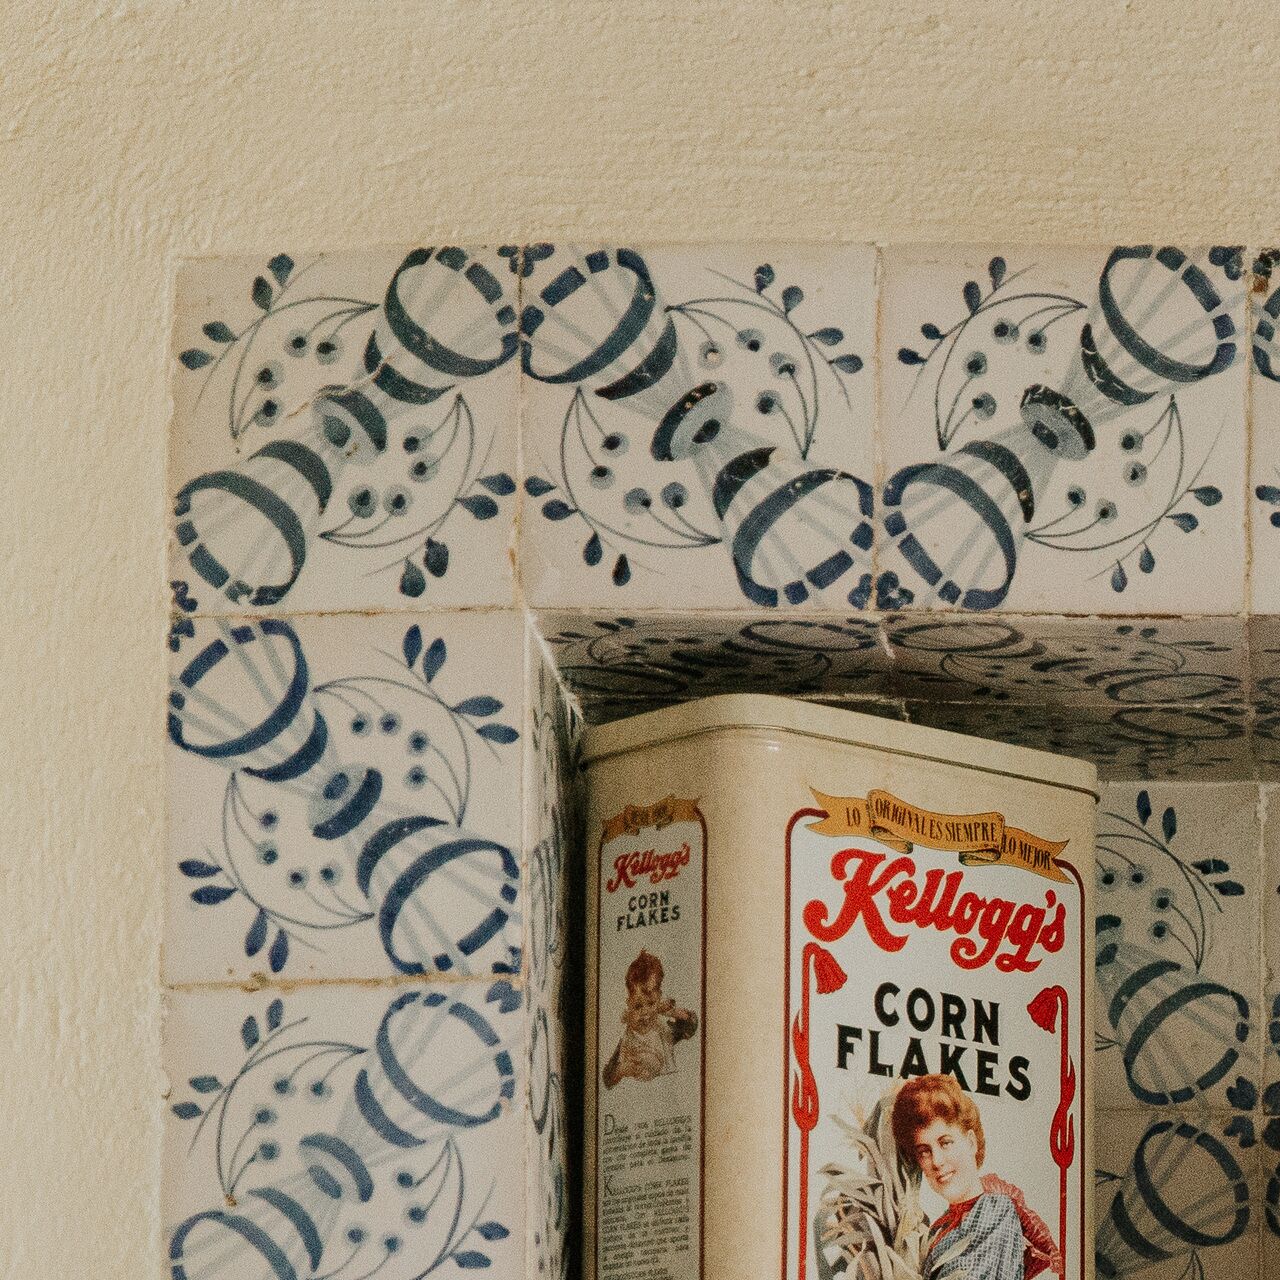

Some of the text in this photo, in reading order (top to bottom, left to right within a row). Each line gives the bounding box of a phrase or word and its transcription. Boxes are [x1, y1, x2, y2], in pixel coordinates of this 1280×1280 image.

[845, 799, 1051, 870] LO ORIGINAL ES SIEMPRE LO MEJOR
[606, 842, 690, 893] Kellogg's
[616, 905, 680, 931] FLAKES
[628, 890, 669, 912] CORN
[803, 848, 1066, 973] Kellogg's
[874, 981, 1000, 1046] CORN
[836, 1023, 1032, 1101] FLAKES
